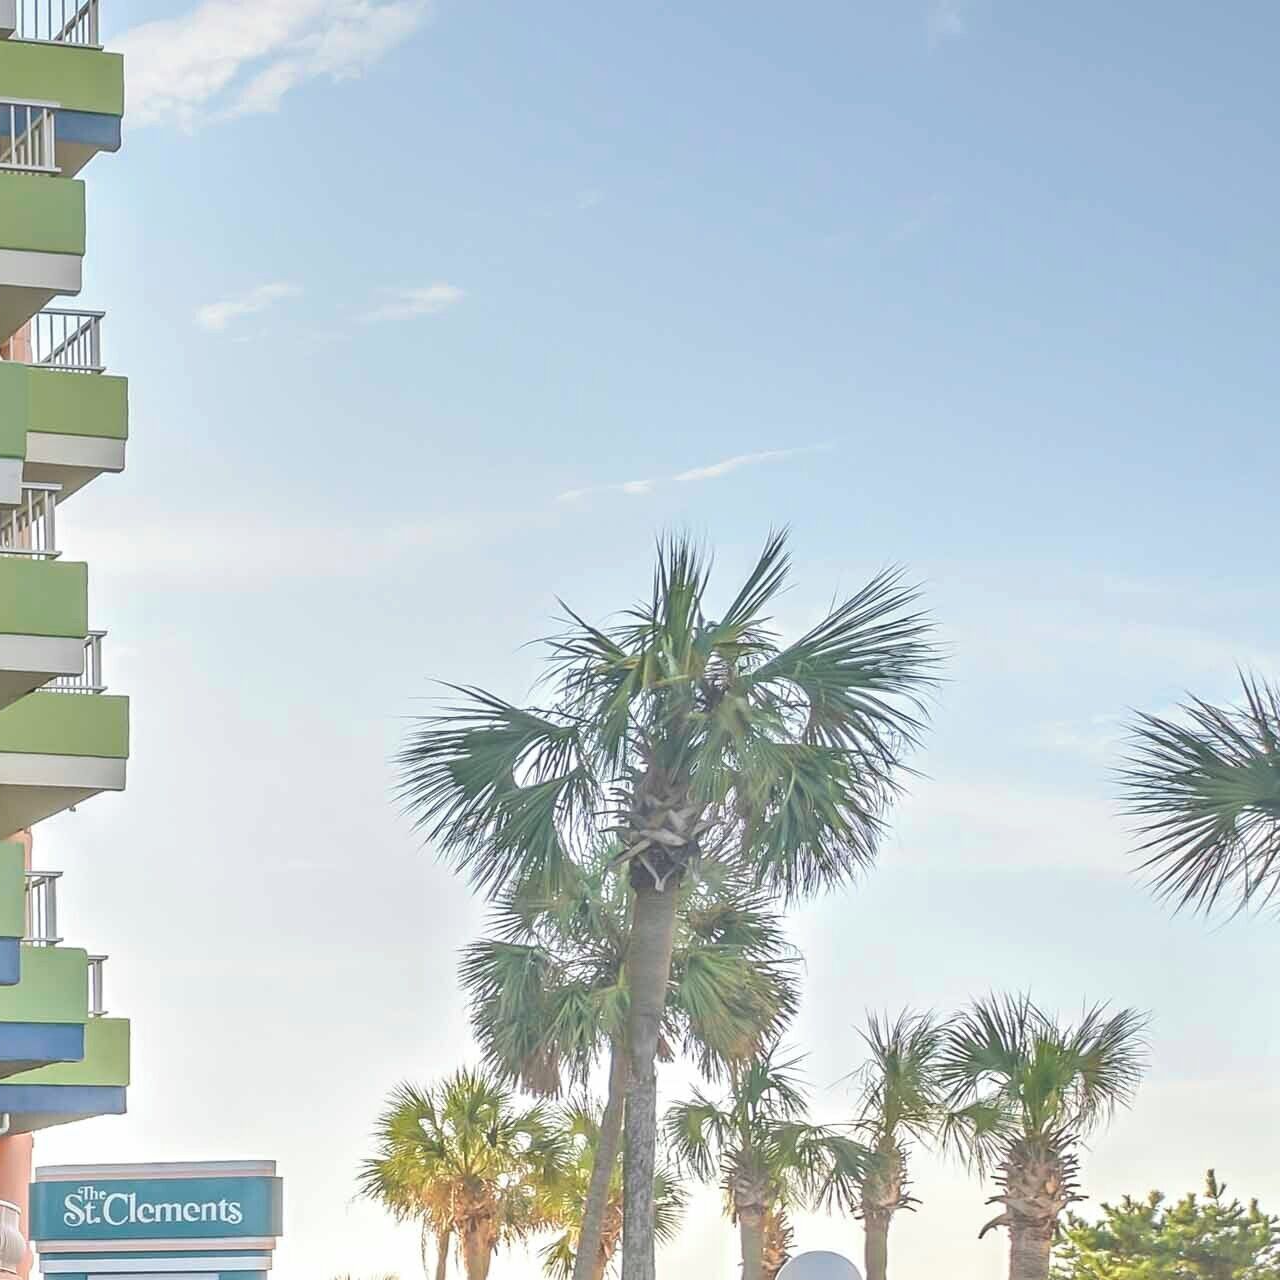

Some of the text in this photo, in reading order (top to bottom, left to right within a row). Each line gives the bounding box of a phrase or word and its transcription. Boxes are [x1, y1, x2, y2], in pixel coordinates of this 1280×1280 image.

[78, 1186, 107, 1200] The
[63, 1192, 243, 1227] St. Clements
